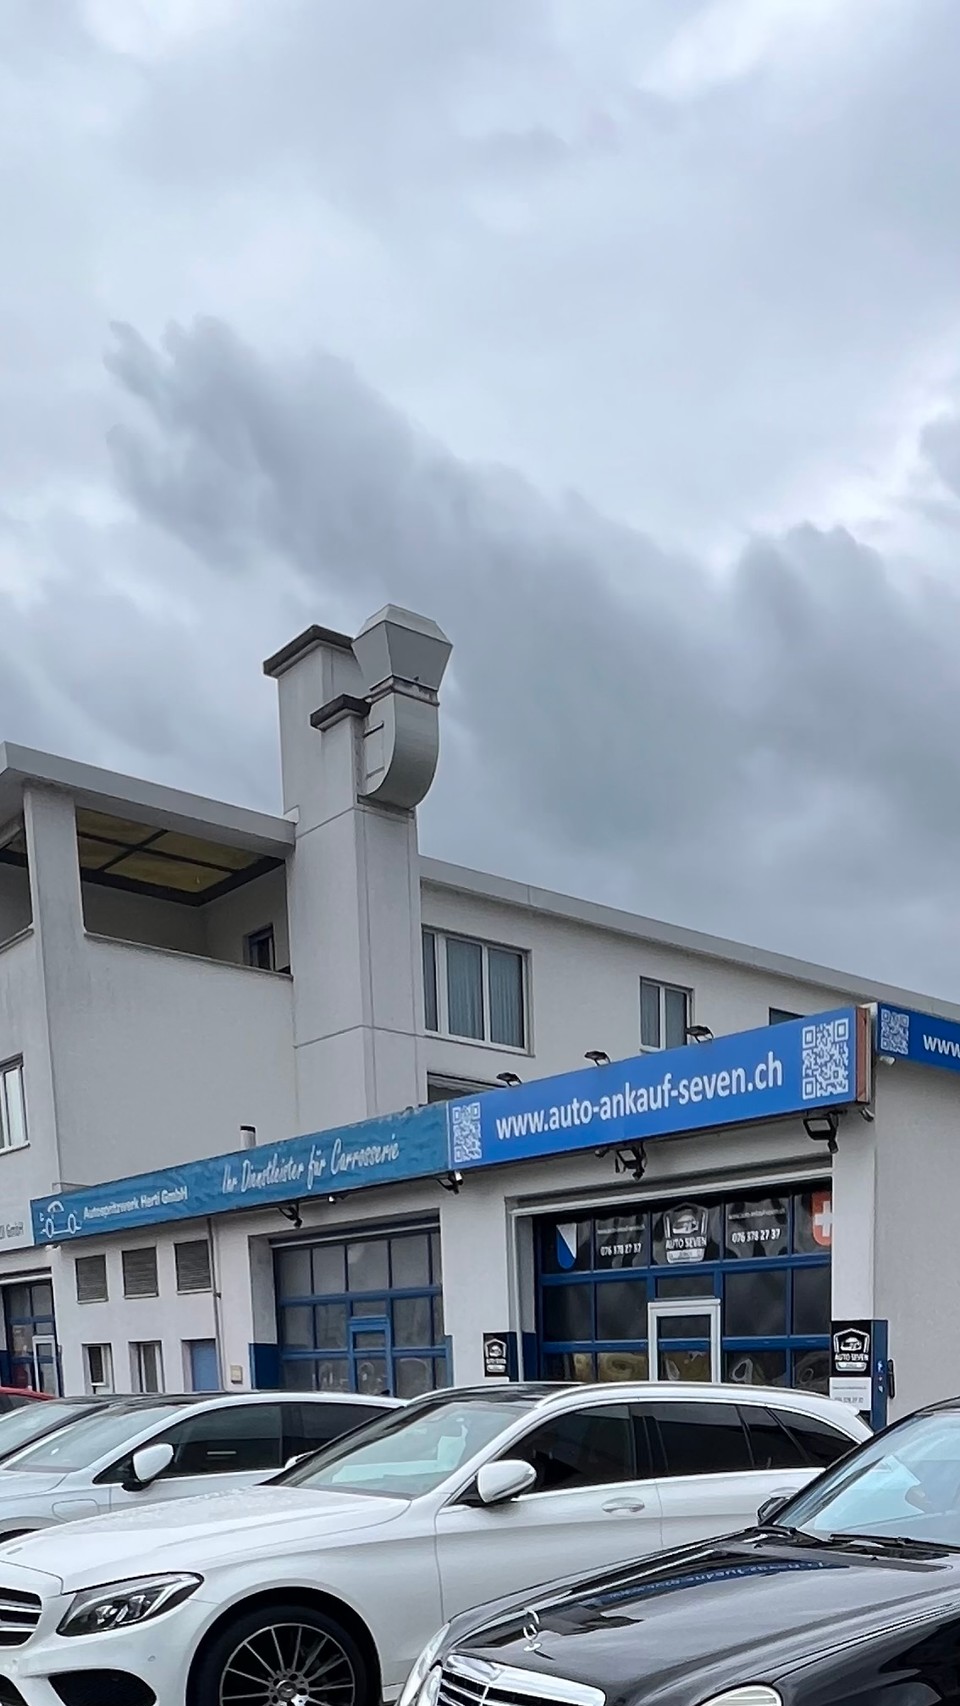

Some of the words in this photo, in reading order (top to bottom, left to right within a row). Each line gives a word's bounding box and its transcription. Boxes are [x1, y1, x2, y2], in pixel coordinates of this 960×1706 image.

[496, 1051, 783, 1140] www.auto-ankauf-seven.ch
[307, 1144, 326, 1190] für
[330, 1133, 400, 1175] Carrosserie
[161, 1185, 188, 1204] GmbH
